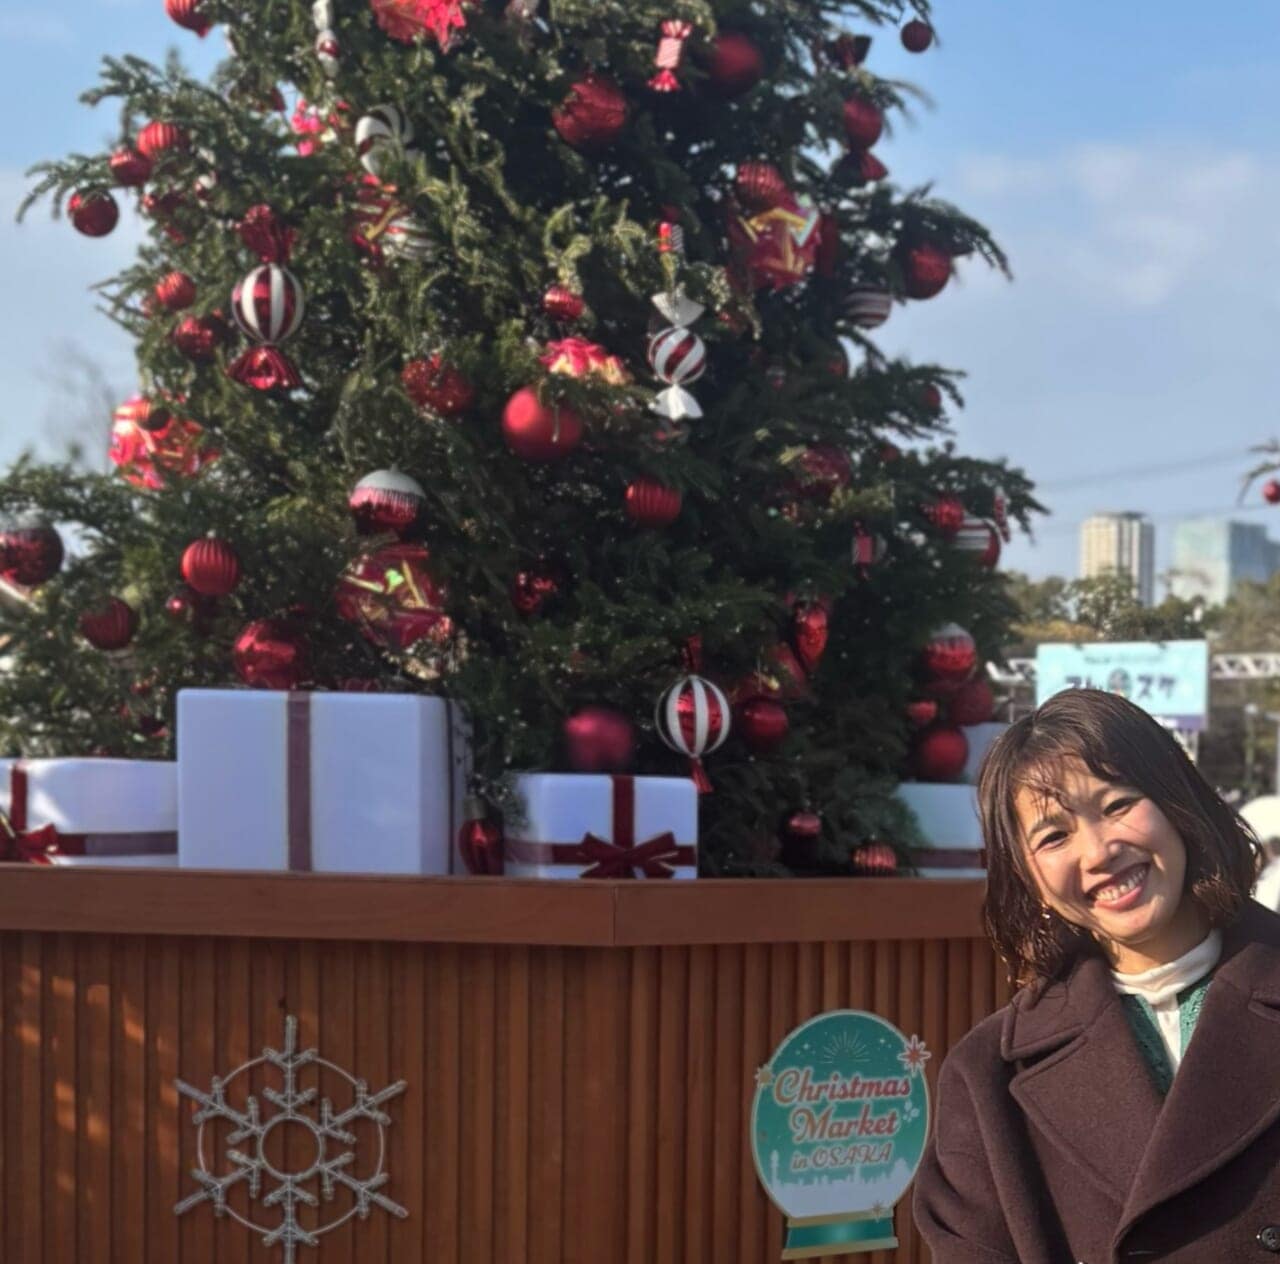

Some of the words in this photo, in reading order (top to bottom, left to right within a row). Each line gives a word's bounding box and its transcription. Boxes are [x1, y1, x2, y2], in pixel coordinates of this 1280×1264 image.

[774, 1066, 912, 1104] Christmas
[791, 1104, 899, 1142] Market
[792, 1152, 808, 1170] in
[812, 1143, 893, 1168] OSAKA
